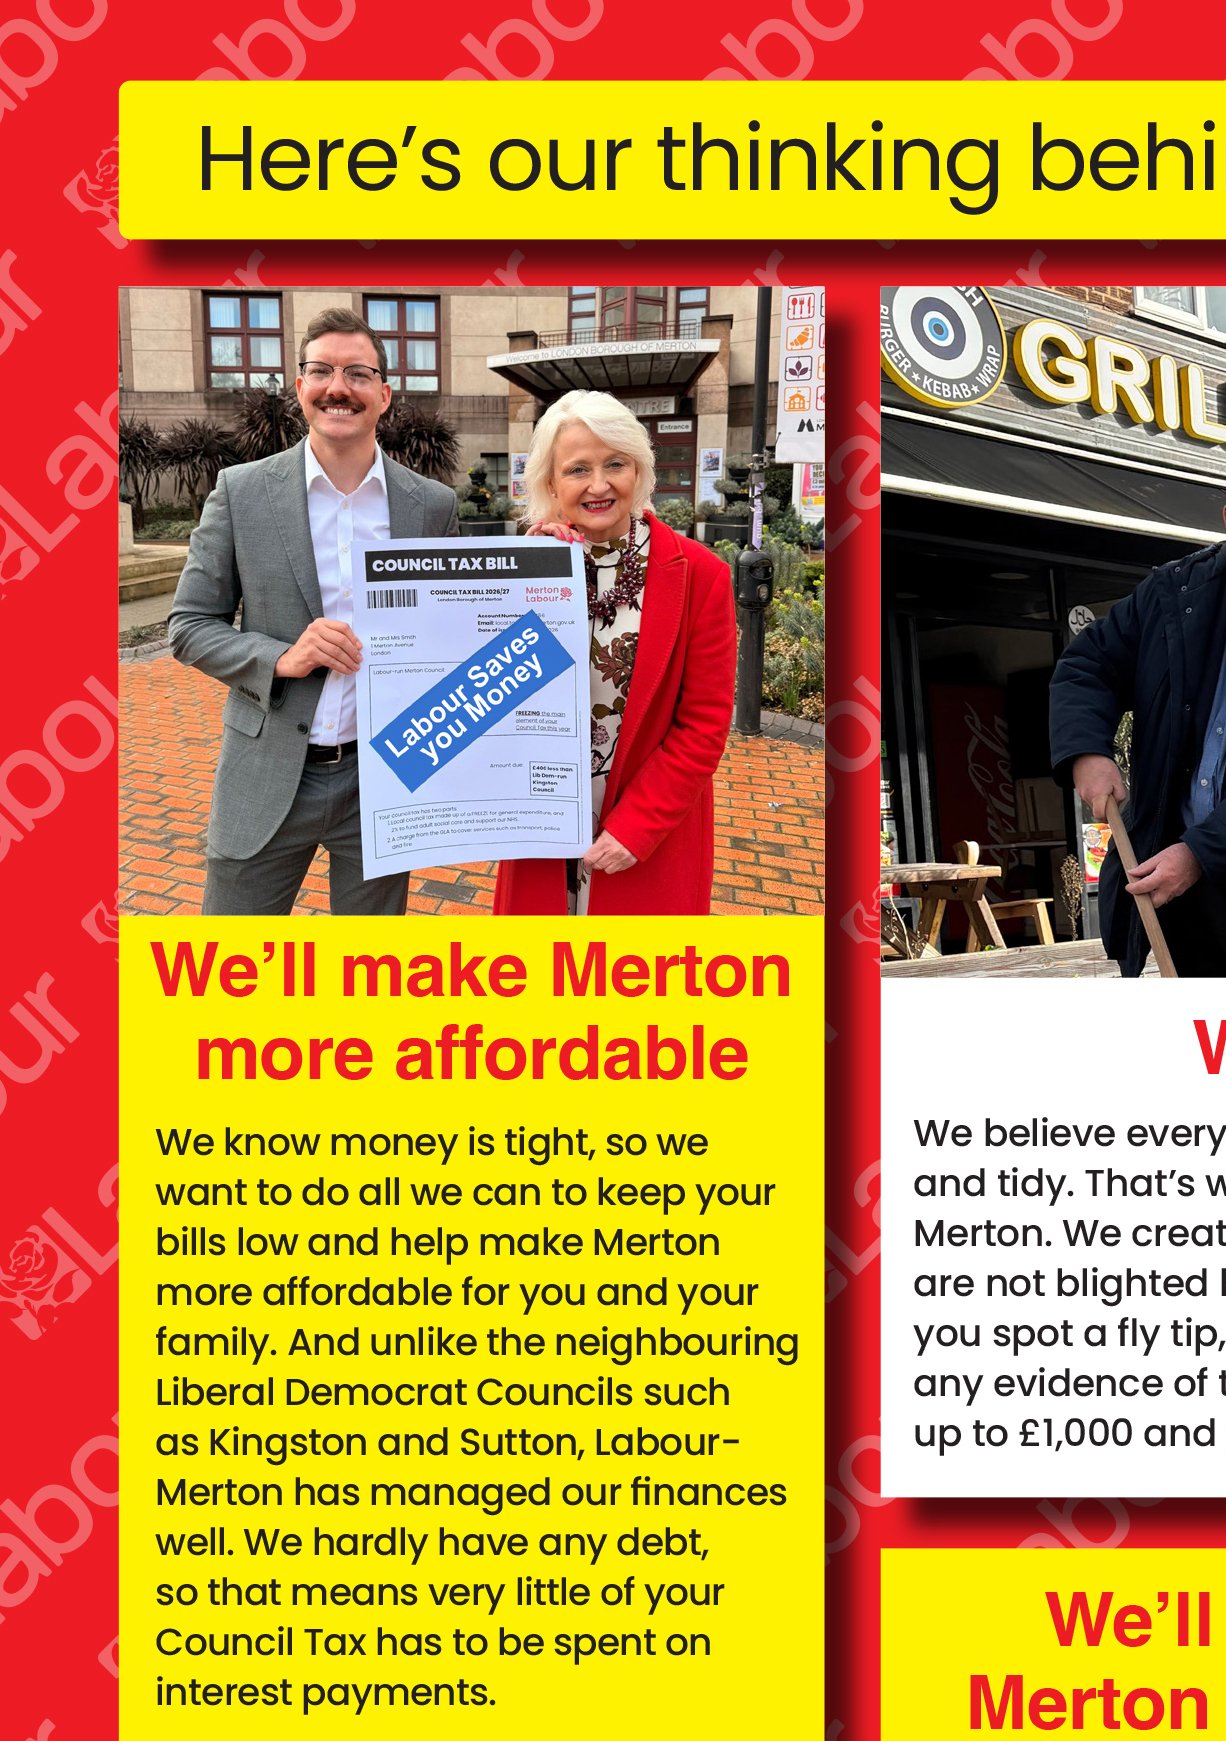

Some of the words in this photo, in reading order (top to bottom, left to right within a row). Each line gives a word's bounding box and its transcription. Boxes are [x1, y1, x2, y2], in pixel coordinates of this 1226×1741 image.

[490, 139, 632, 191] our
[657, 120, 998, 215] thinking
[505, 353, 540, 363] Welcome
[541, 351, 549, 359] to
[551, 346, 589, 358] LONDON
[590, 344, 638, 355] BOROUGH
[640, 342, 654, 352] OF
[655, 341, 697, 351] MERTON
[922, 375, 972, 399] KEBAB
[975, 344, 1001, 388] WRAP
[660, 423, 690, 431] Entrance
[371, 557, 446, 573] COUNCIL
[447, 557, 483, 571] TAX
[485, 556, 518, 571] BILL
[485, 587, 510, 596] 2026/27
[525, 586, 560, 594] Merton
[525, 595, 559, 603] Labour
[384, 683, 468, 758] Labour
[467, 626, 540, 688] Saves
[420, 718, 468, 767] you
[463, 653, 544, 723] Money
[344, 942, 526, 997] make
[554, 942, 789, 997] Merton
[199, 1038, 372, 1080] more
[396, 1024, 747, 1080] affordable
[913, 1325, 980, 1356] you
[993, 1320, 1073, 1356] spot
[1084, 1325, 1106, 1347] a
[1118, 1317, 1160, 1356] fly
[1171, 1317, 1226, 1356] tip,
[157, 1376, 273, 1406] Liberal
[286, 1379, 467, 1406] Democrat
[477, 1376, 632, 1406] Councils
[645, 1377, 729, 1406] such
[157, 1676, 292, 1706] interest
[303, 1679, 495, 1715] payments.
[971, 1675, 1207, 1730] Merton
